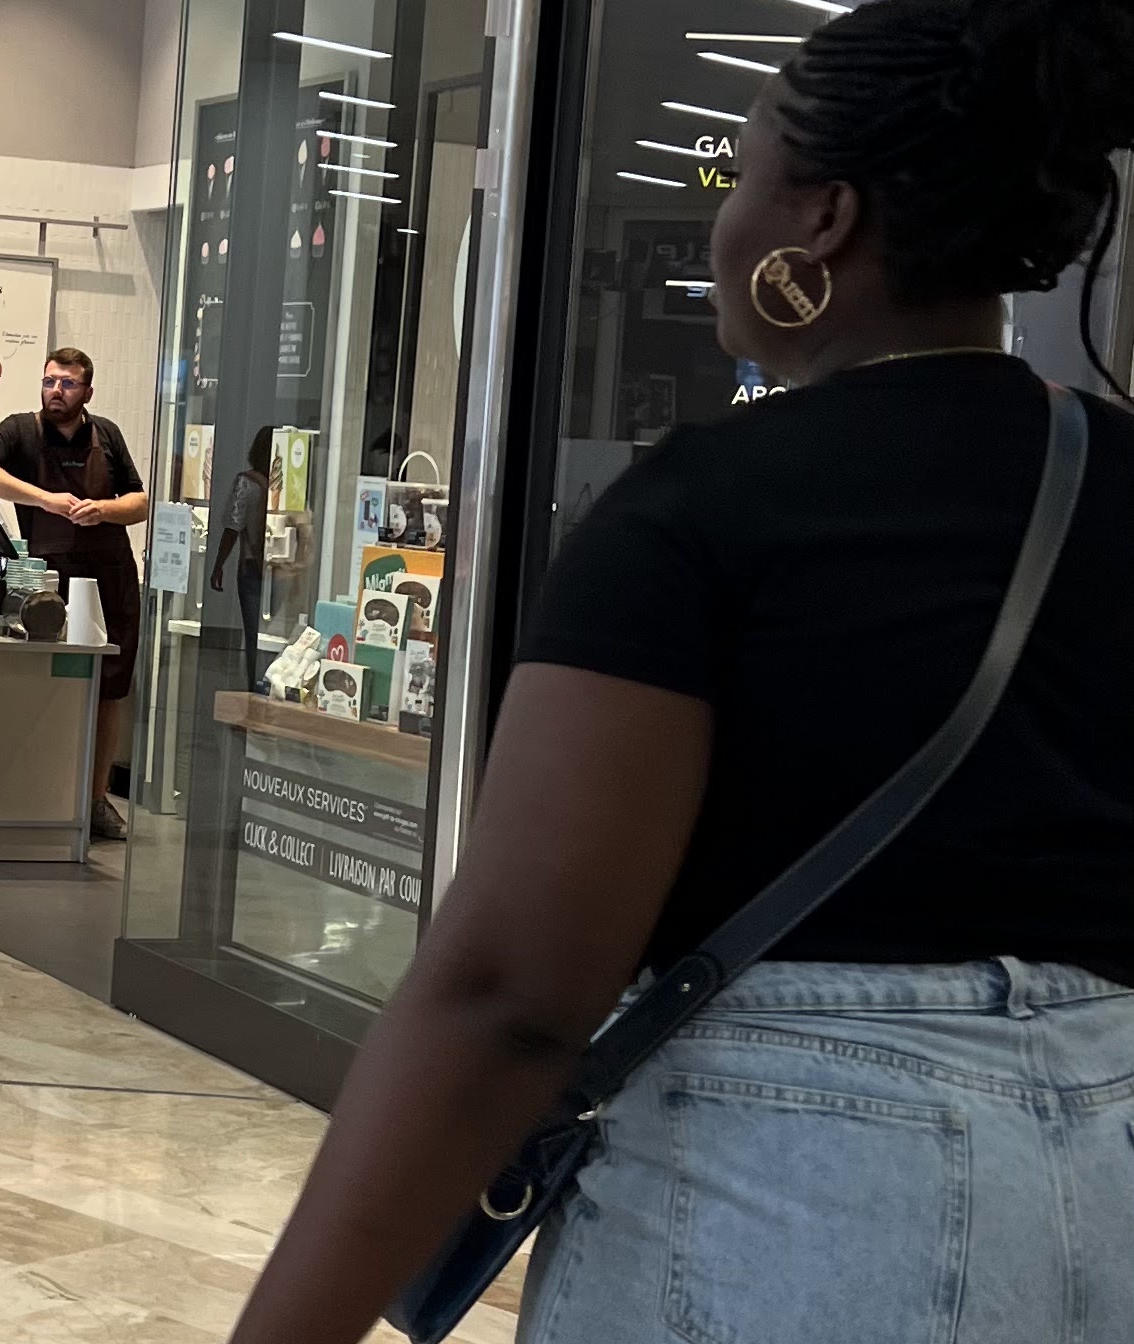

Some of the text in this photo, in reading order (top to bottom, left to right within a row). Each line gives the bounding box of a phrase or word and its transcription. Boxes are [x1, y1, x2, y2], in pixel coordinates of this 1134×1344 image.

[698, 166, 737, 188] VE
[243, 768, 305, 805] NOUVEAUX
[306, 787, 366, 823] SERVICES
[244, 822, 268, 852] CLICK
[268, 830, 279, 856] &
[280, 834, 315, 866] COLLECT
[329, 850, 377, 890] LIVRAISON
[378, 867, 396, 896] PAR
